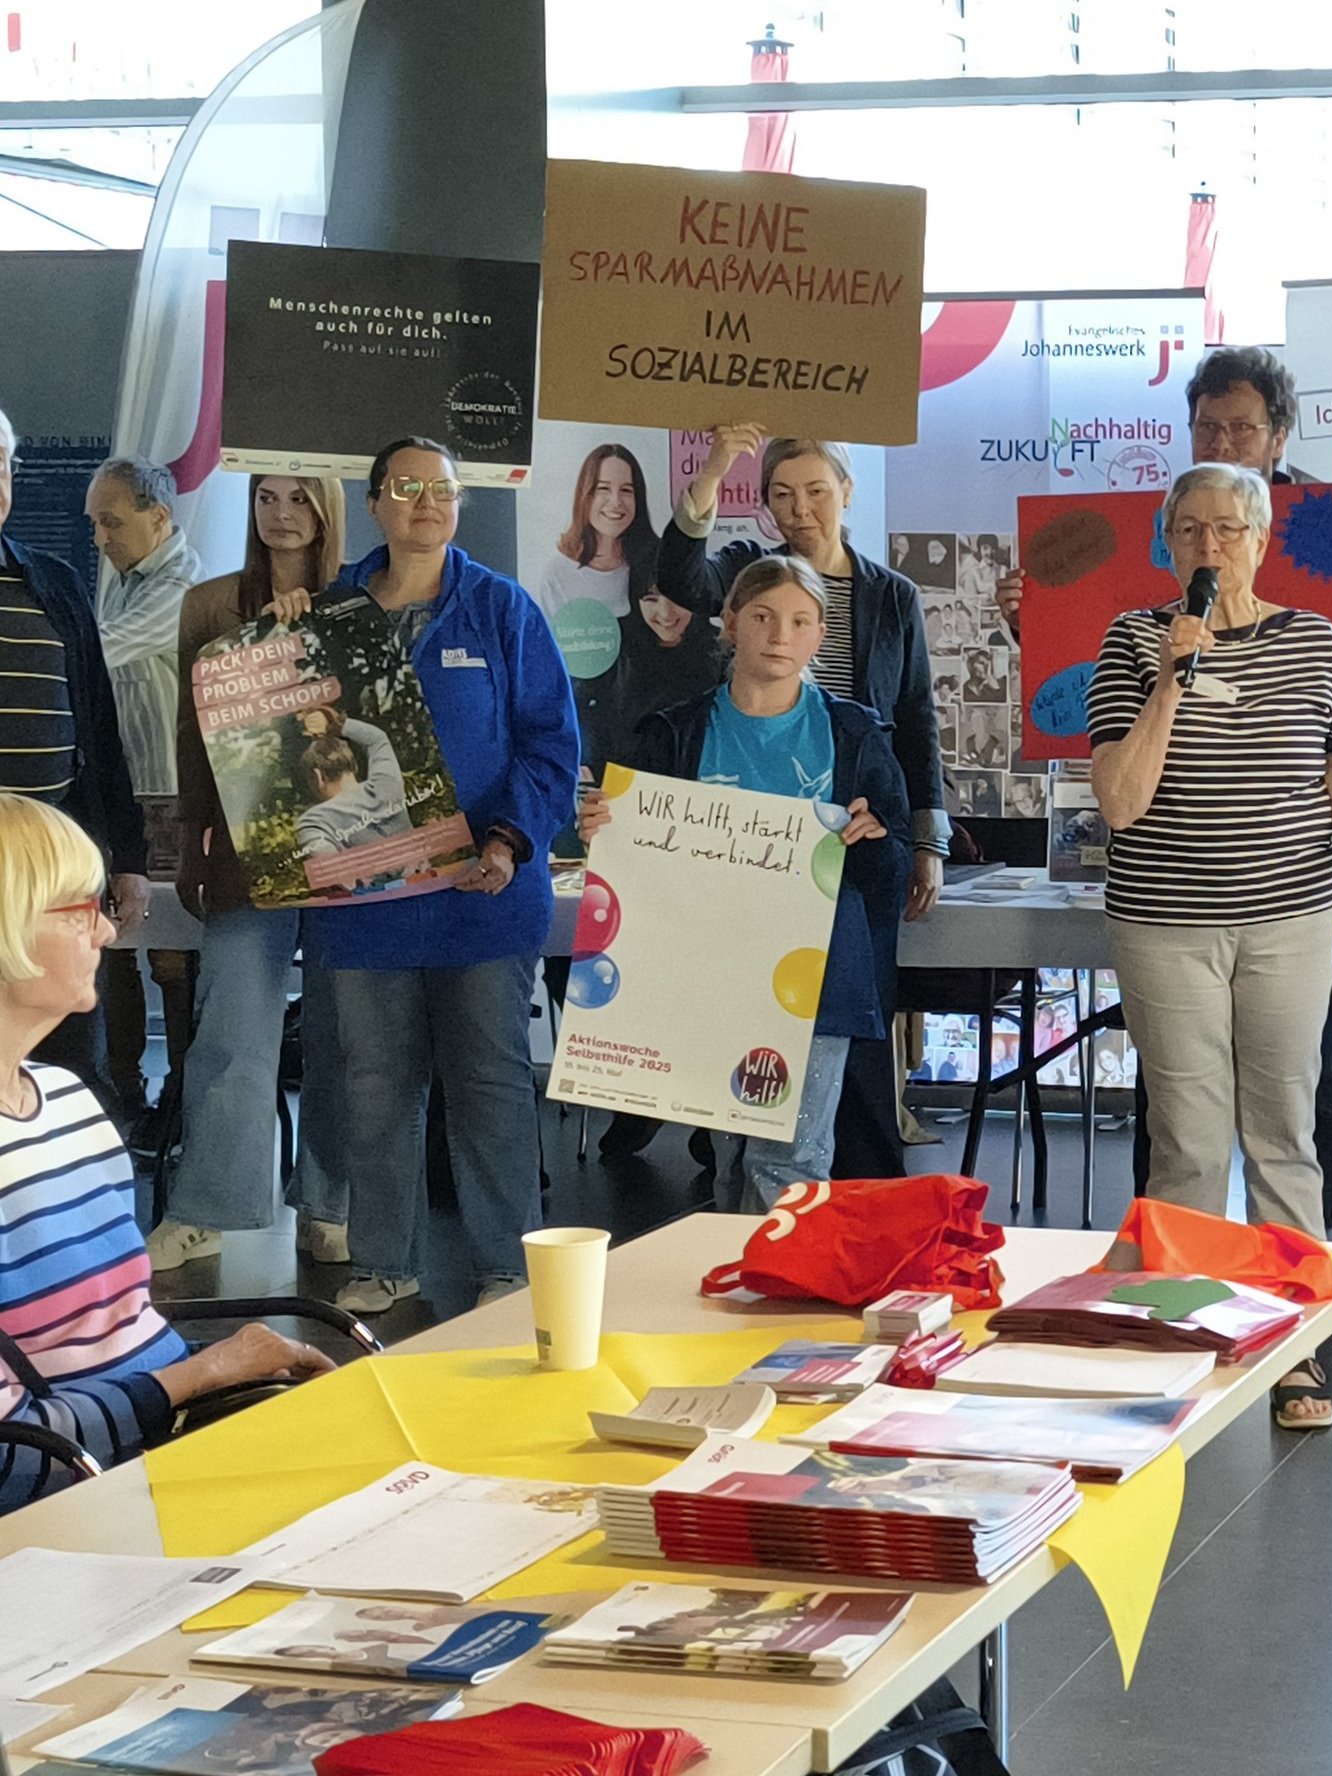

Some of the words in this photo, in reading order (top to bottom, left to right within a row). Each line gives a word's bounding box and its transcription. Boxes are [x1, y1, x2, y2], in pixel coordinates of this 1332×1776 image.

[679, 196, 809, 253] KEINE
[569, 250, 903, 308] SPARMAßNAHMEN
[269, 297, 424, 320] Menschenrechte
[433, 310, 492, 325] gelten
[315, 320, 358, 334] auch
[367, 323, 394, 336] für
[402, 326, 448, 340] dich.
[704, 310, 751, 343] IM
[360, 343, 382, 355] auf
[1021, 339, 1146, 357] Johanneswerk
[604, 343, 870, 396] SOZIALBEREICH
[1051, 418, 1172, 446] Nachhaltig
[251, 639, 297, 663] DEIN
[202, 668, 290, 702] PROBLEM
[207, 703, 254, 727] BEIM
[259, 682, 335, 715] SCHOPF
[638, 790, 675, 822] WIR
[741, 809, 802, 843] stärkt
[633, 826, 680, 853] und
[690, 838, 801, 876] verbindet.
[566, 1045, 635, 1066] Selbsthilfe
[638, 1058, 672, 1073] 2025
[568, 1033, 661, 1058] Aktionswoche
[744, 1050, 780, 1079] WIR
